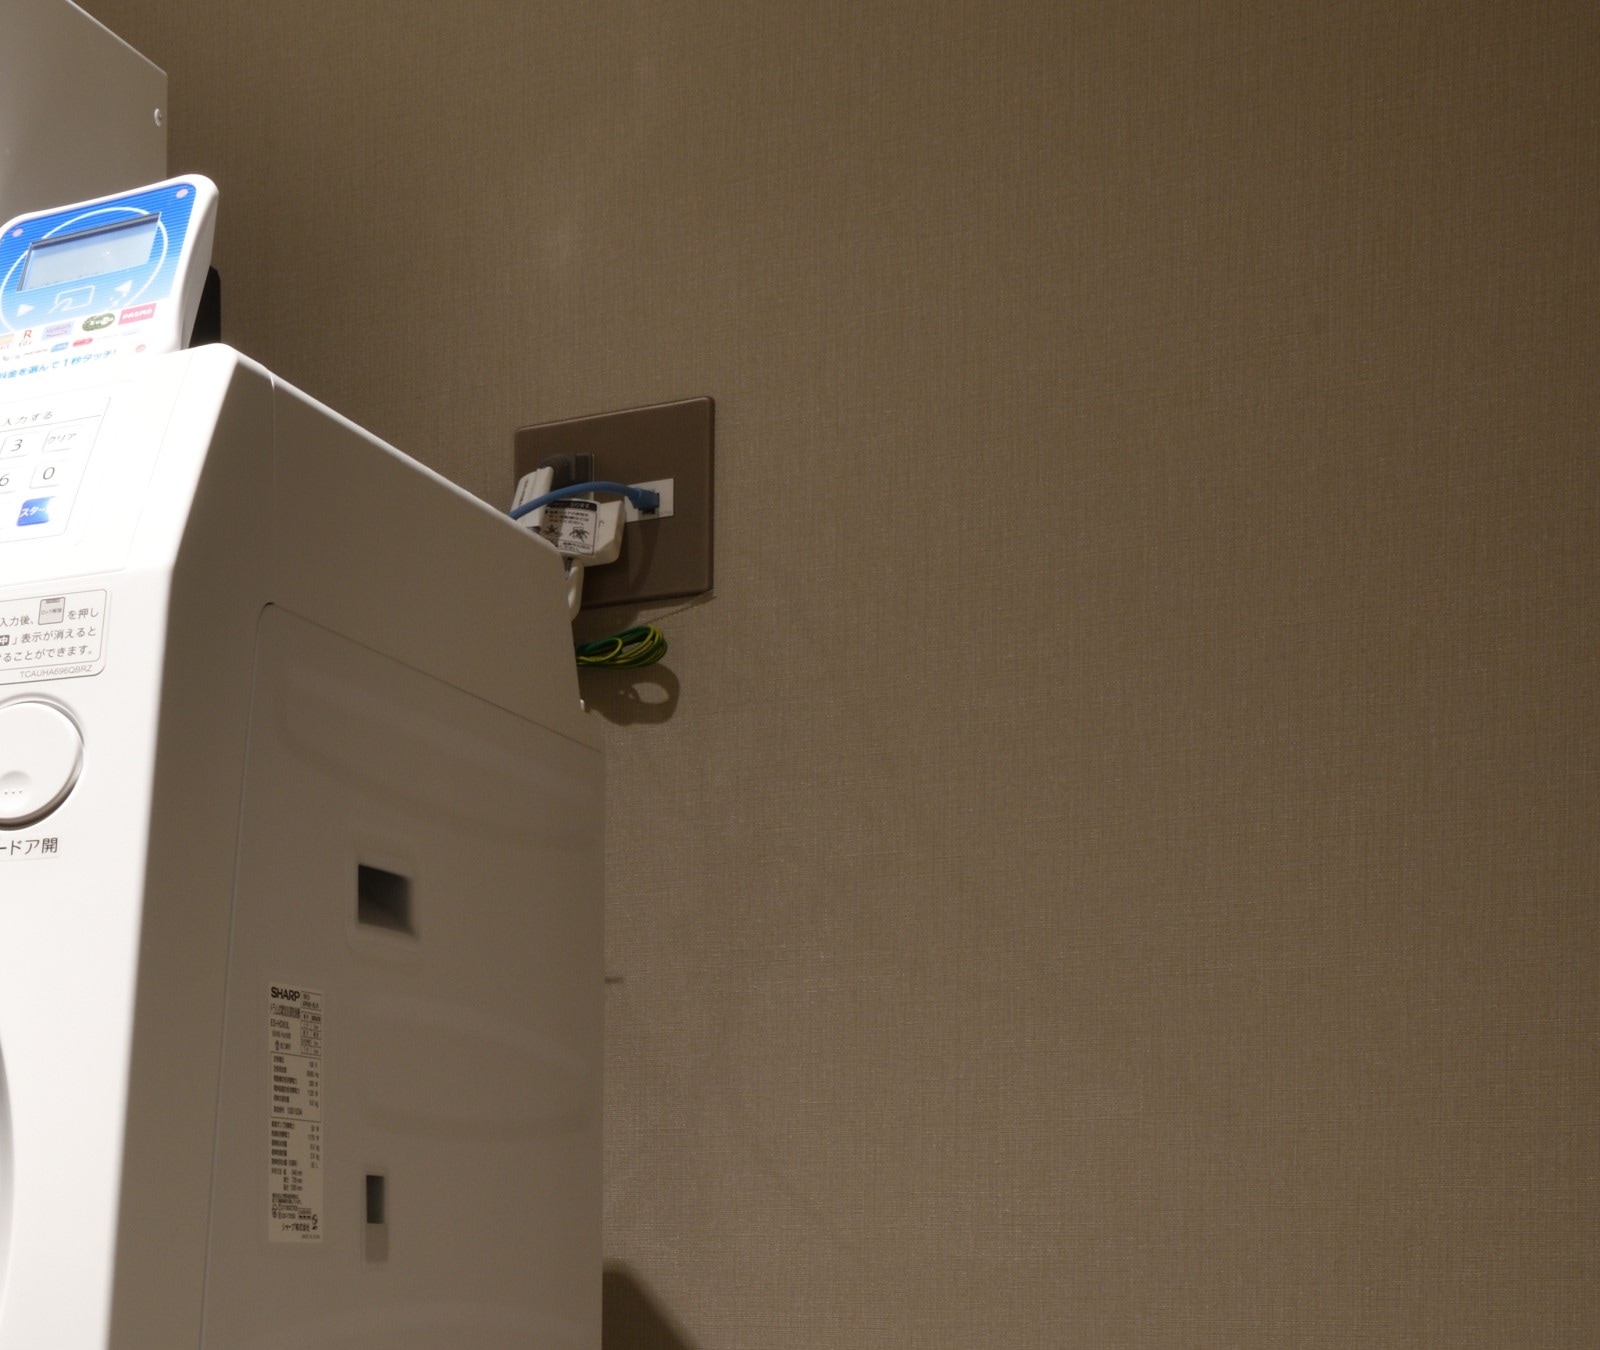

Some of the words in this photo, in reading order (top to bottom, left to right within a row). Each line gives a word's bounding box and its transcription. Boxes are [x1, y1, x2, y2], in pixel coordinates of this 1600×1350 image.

[11, 439, 23, 451] 3
[43, 467, 55, 480] 0
[68, 607, 99, 619] を押し
[271, 986, 300, 1001] SHARP
